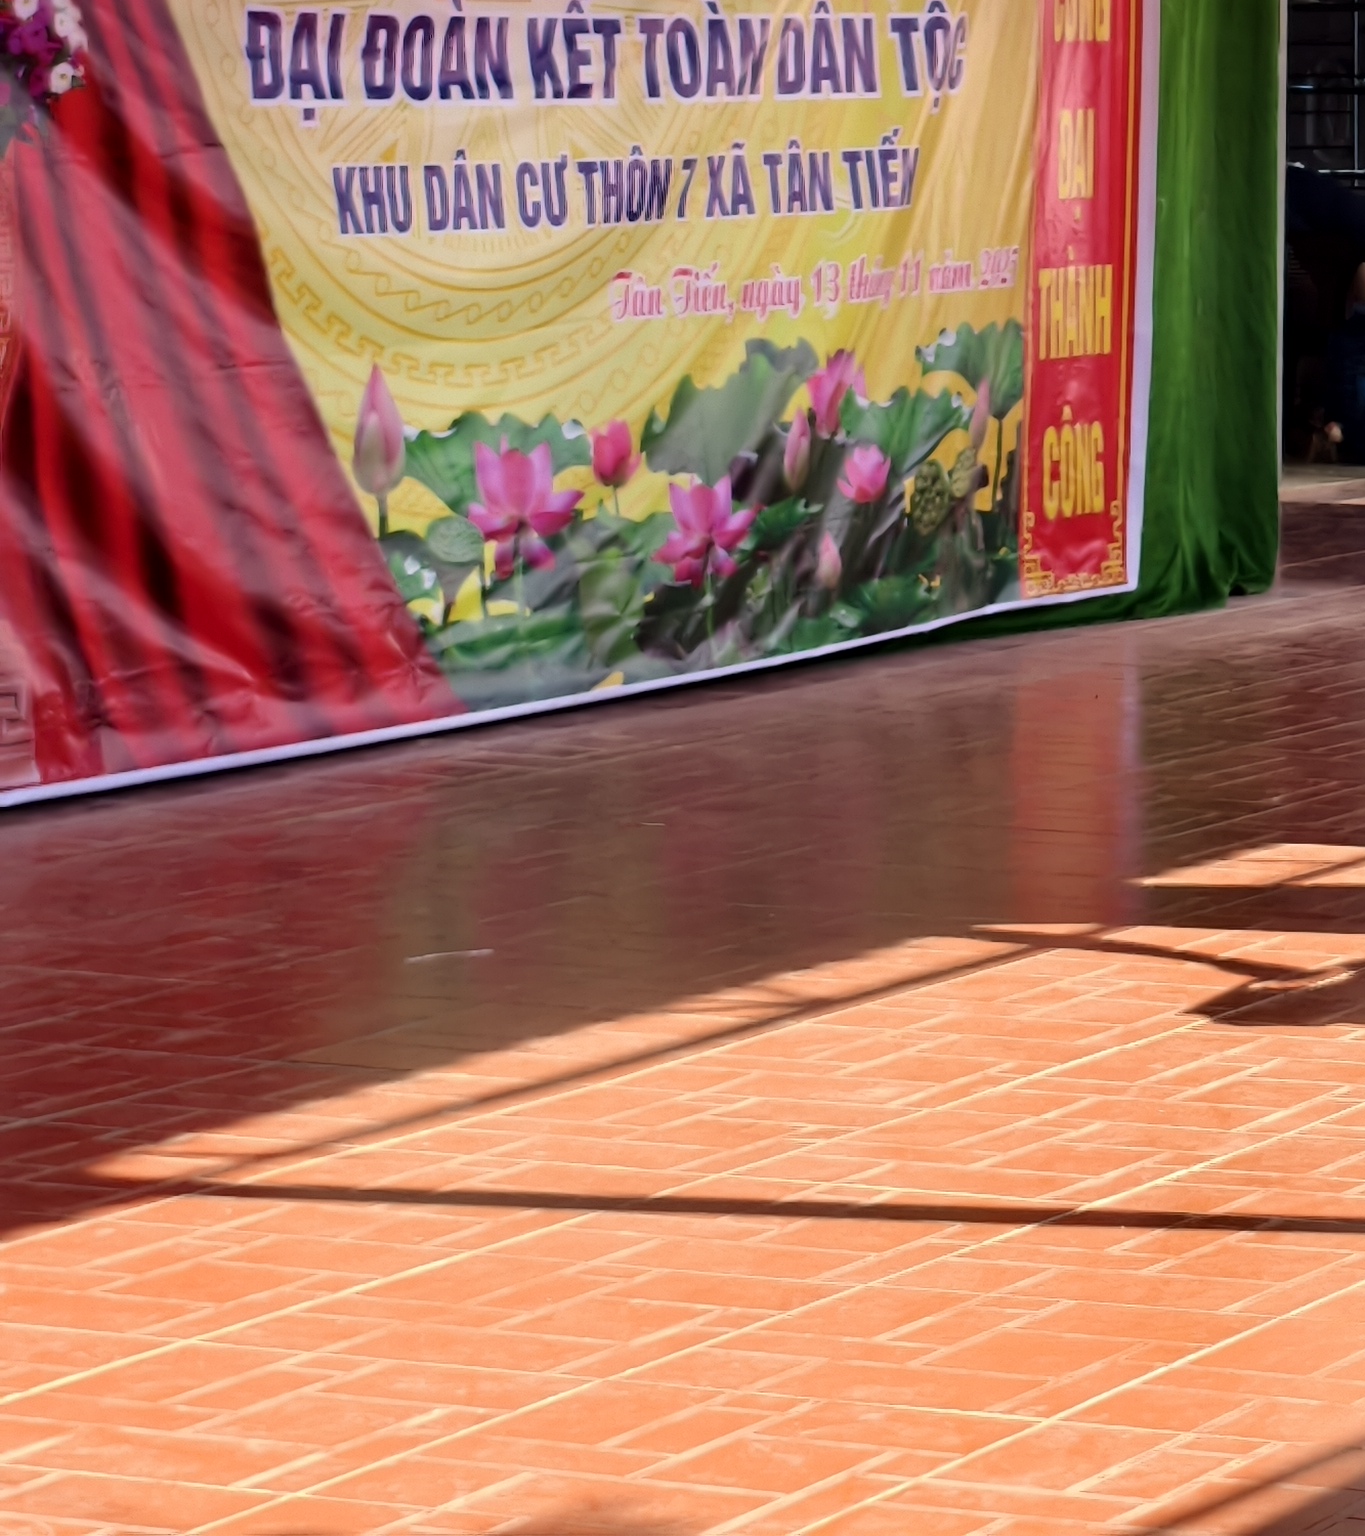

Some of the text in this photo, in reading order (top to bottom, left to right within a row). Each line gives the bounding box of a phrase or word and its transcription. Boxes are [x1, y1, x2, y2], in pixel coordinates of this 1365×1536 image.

[246, 11, 345, 121] ĐẠI
[639, 1, 770, 98] TOÀN
[777, 0, 878, 95] DÂN
[890, 0, 967, 109] TỘC
[332, 128, 920, 234] KHU DÂN CƯ THÔN 7 XÃ TÂN TIẾN
[1057, 108, 1095, 221] ĐẠI
[612, 271, 664, 320] Tân
[741, 265, 801, 317] ngày
[812, 262, 840, 304] 13
[1039, 245, 1114, 360] THÀNH
[1042, 405, 1105, 521] CÔNG
